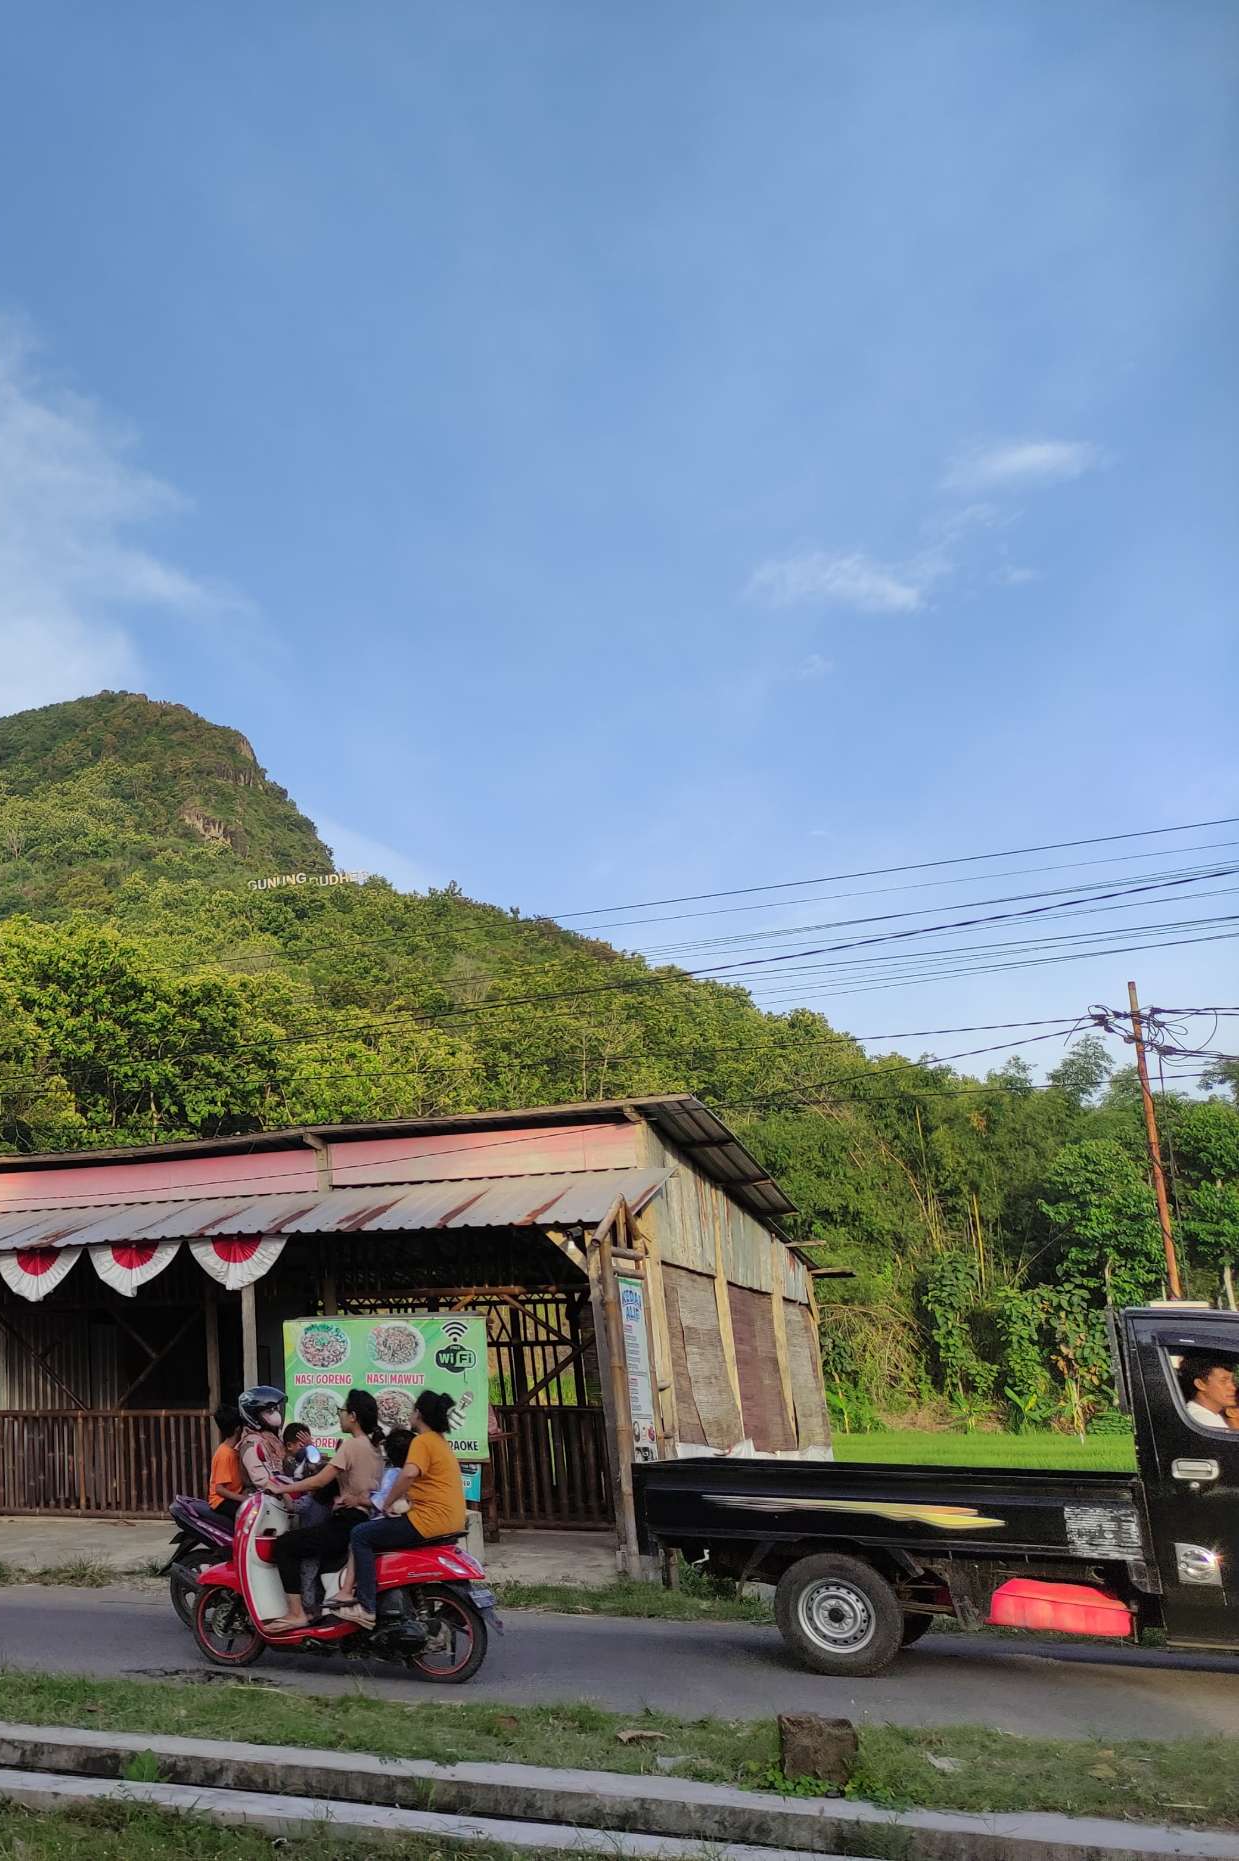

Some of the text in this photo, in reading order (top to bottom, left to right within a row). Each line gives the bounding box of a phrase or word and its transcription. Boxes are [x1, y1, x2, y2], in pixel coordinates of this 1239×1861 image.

[248, 872, 306, 890] GUNUNG
[296, 1375, 352, 1384] NASI GORENG
[367, 1374, 424, 1384] NASI MAWUT
[448, 1440, 479, 1451] RAOKE
